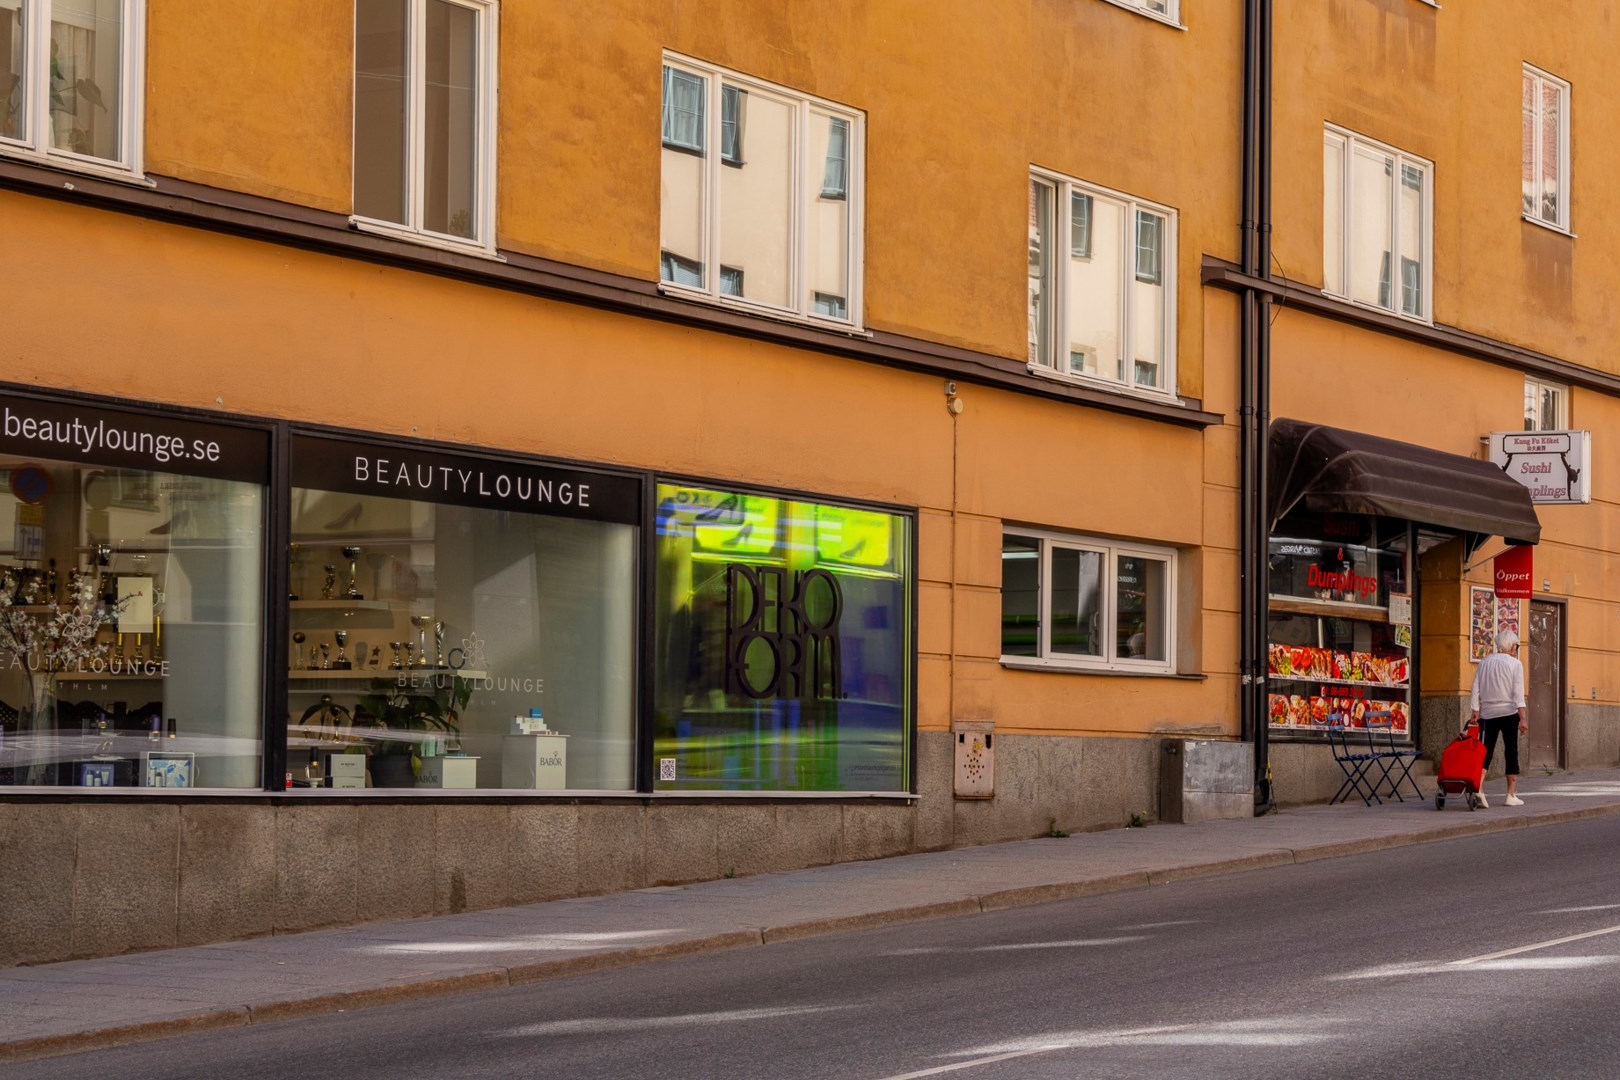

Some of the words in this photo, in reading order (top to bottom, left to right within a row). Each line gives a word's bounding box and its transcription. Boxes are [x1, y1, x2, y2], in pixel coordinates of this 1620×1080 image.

[4, 407, 220, 462] beautylounge.se
[1521, 462, 1552, 473] Sushi
[355, 456, 590, 507] BEAUTYLOUNGE
[1337, 547, 1344, 560] &
[1308, 563, 1377, 598] Dumplings
[1496, 569, 1530, 581] Öppet
[398, 672, 544, 693] BEAUTYLOUNGE
